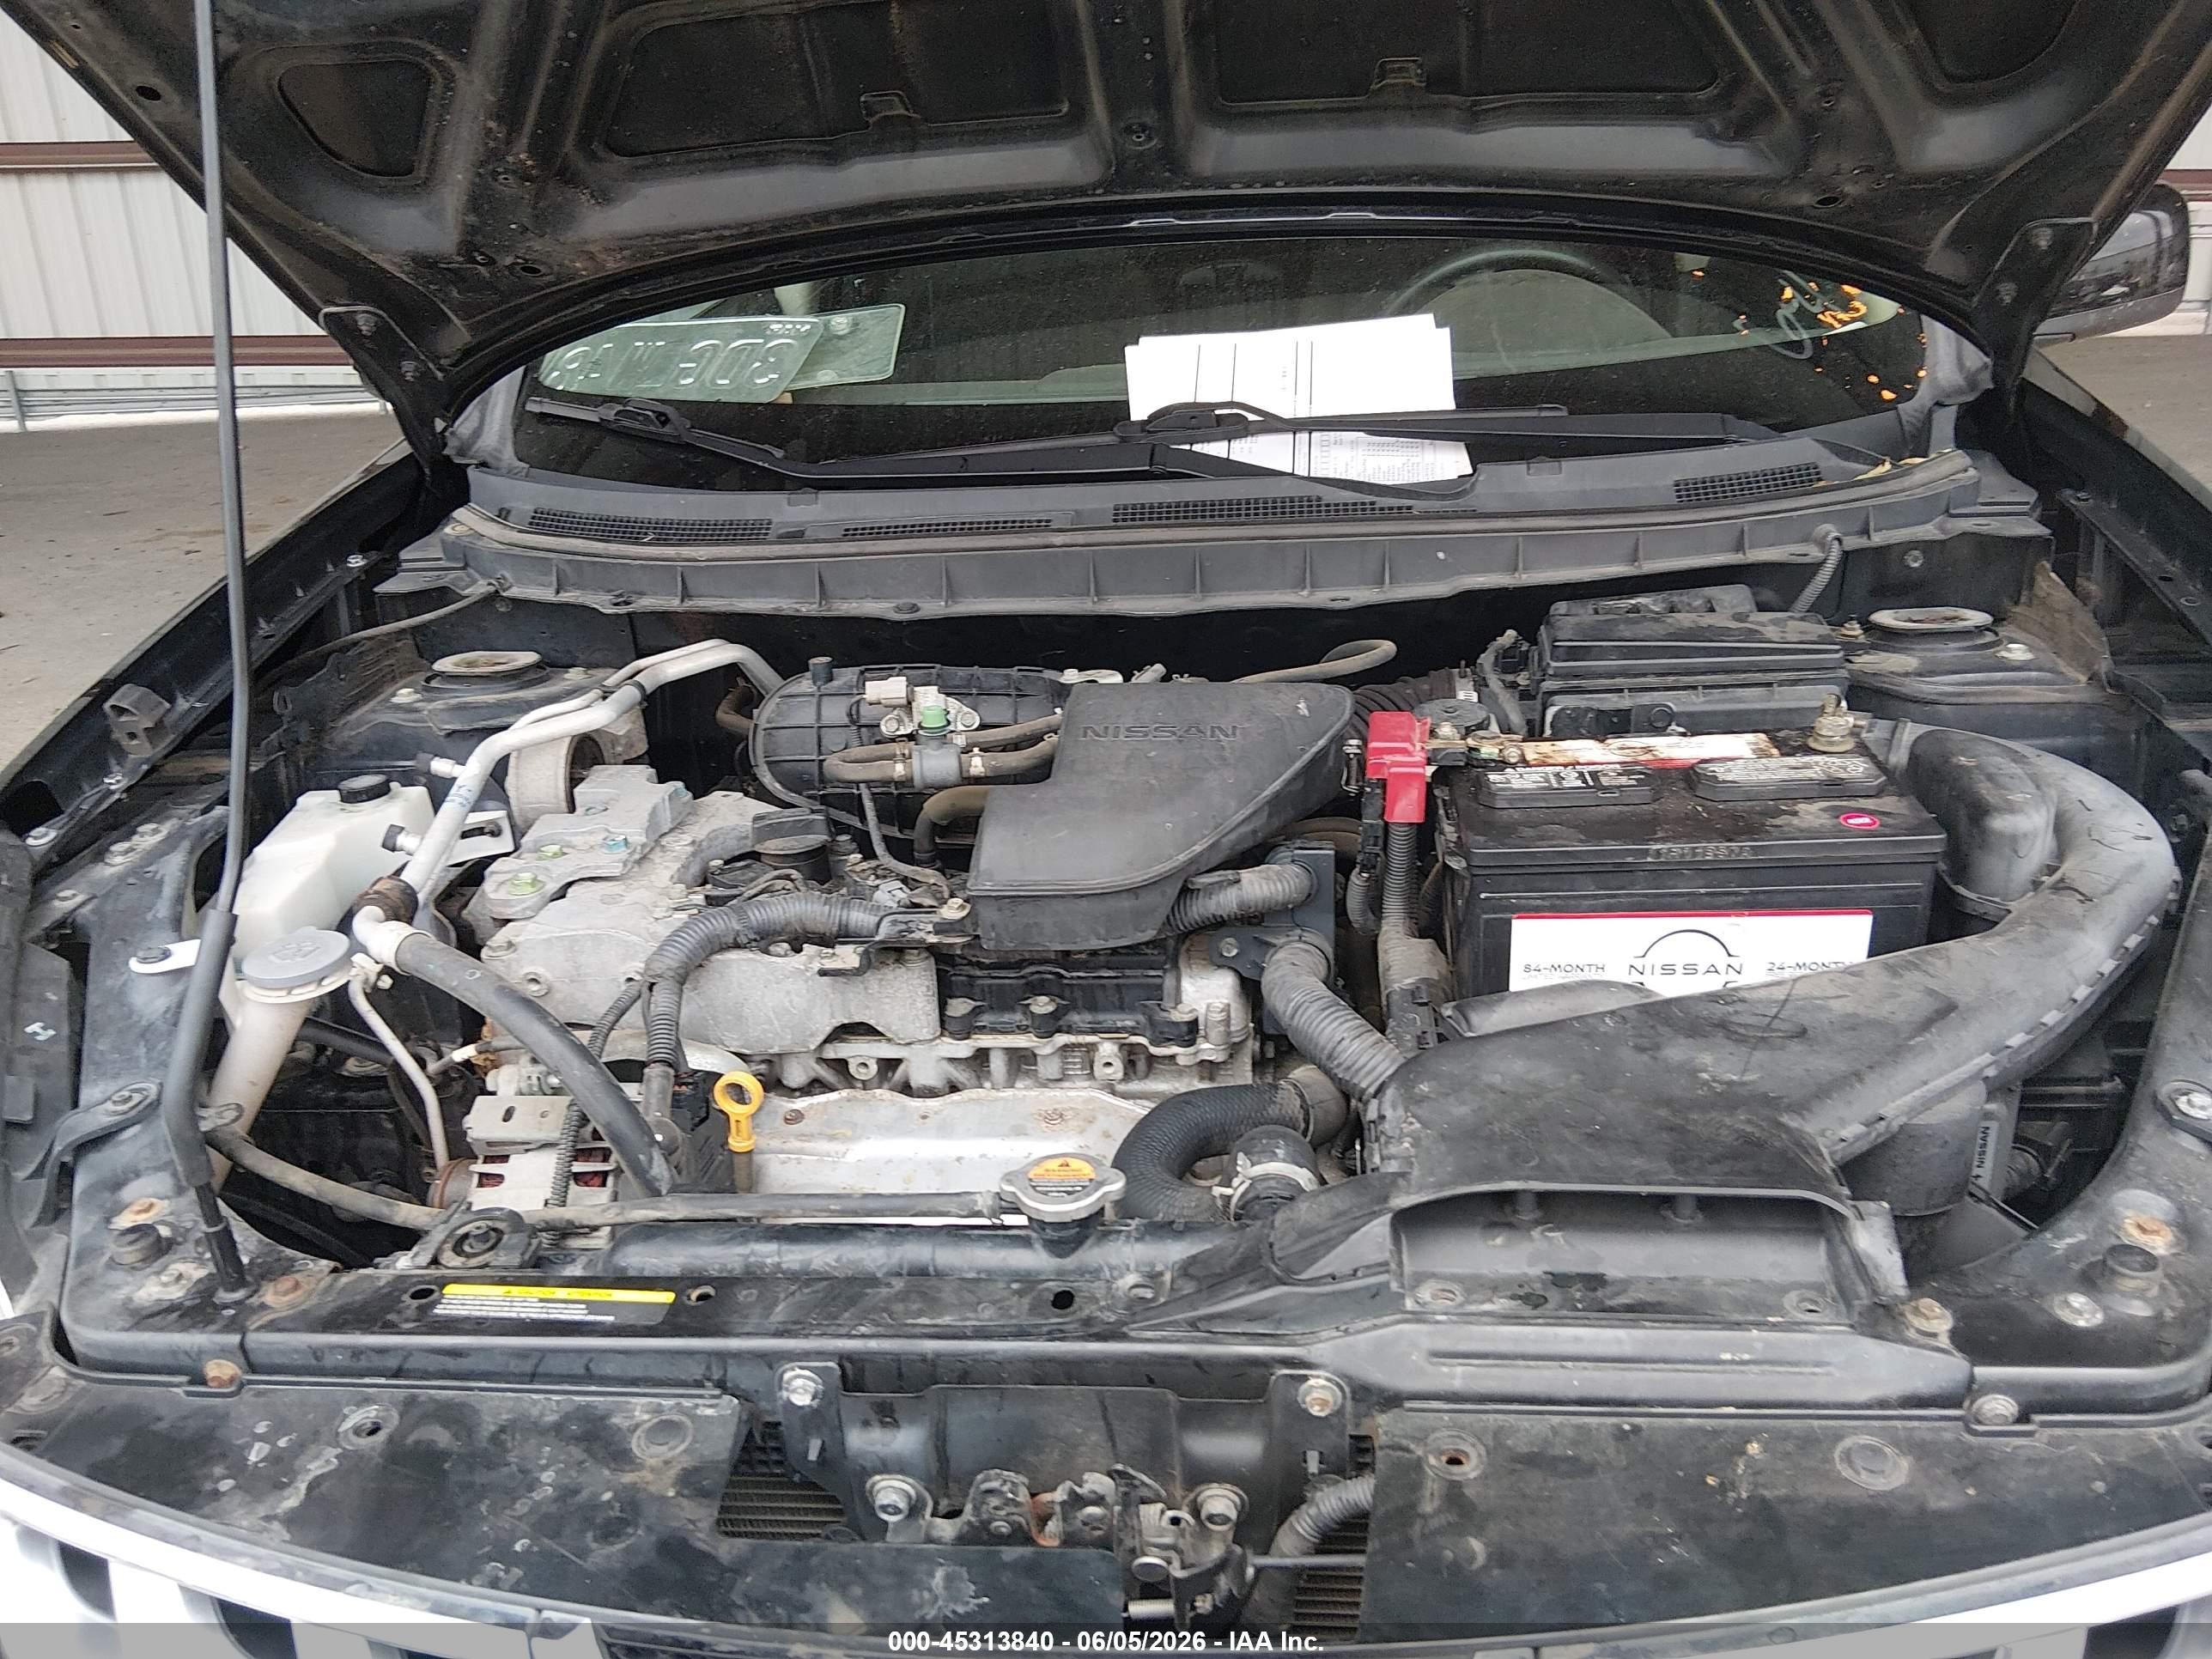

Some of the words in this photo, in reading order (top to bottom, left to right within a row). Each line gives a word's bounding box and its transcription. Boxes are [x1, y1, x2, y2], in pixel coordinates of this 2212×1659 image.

[1082, 724, 1237, 739] NISSAN
[1628, 963, 1744, 975] NISSAN
[1977, 1126, 1990, 1168] NISSAN
